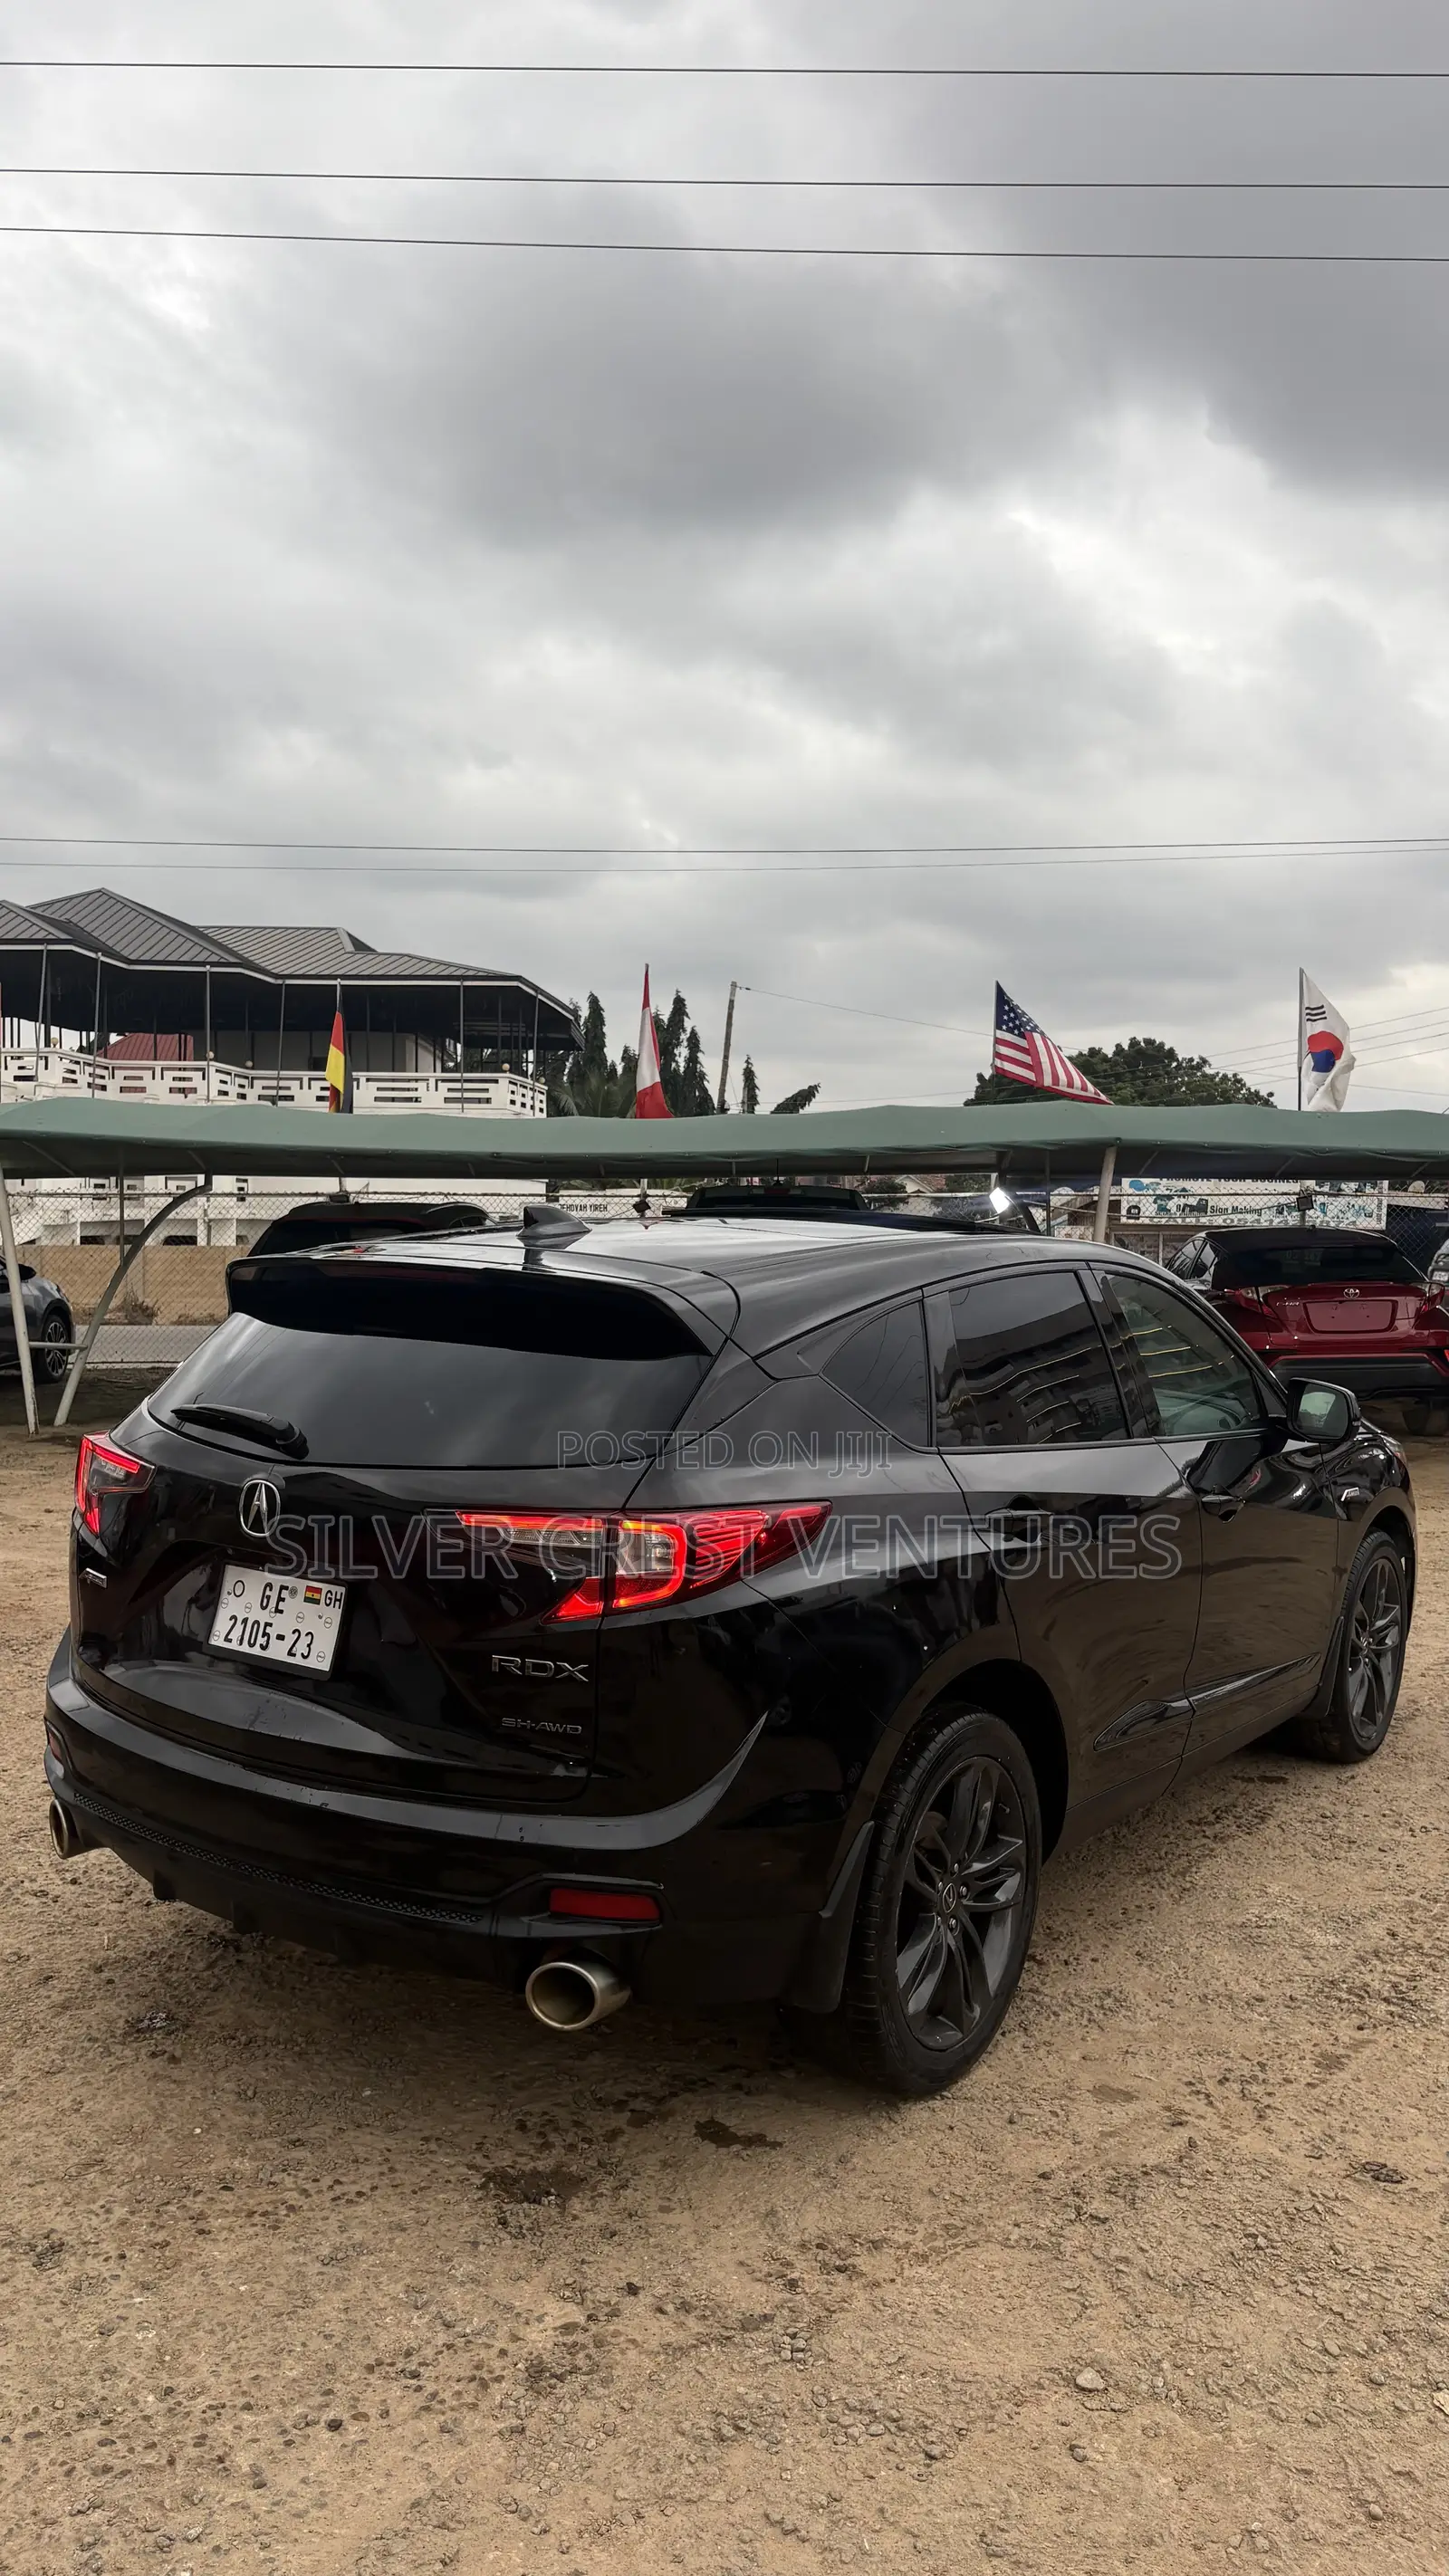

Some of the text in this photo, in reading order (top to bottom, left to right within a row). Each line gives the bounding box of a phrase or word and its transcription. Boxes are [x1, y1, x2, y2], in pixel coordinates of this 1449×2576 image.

[589, 1203, 608, 1212] YIREH
[1231, 1205, 1262, 1216] Making
[259, 1582, 343, 1614] GE GH
[223, 1614, 314, 1660] 2105-23
[491, 1654, 590, 1682] RDX
[501, 1717, 582, 1735] SH-AWD
